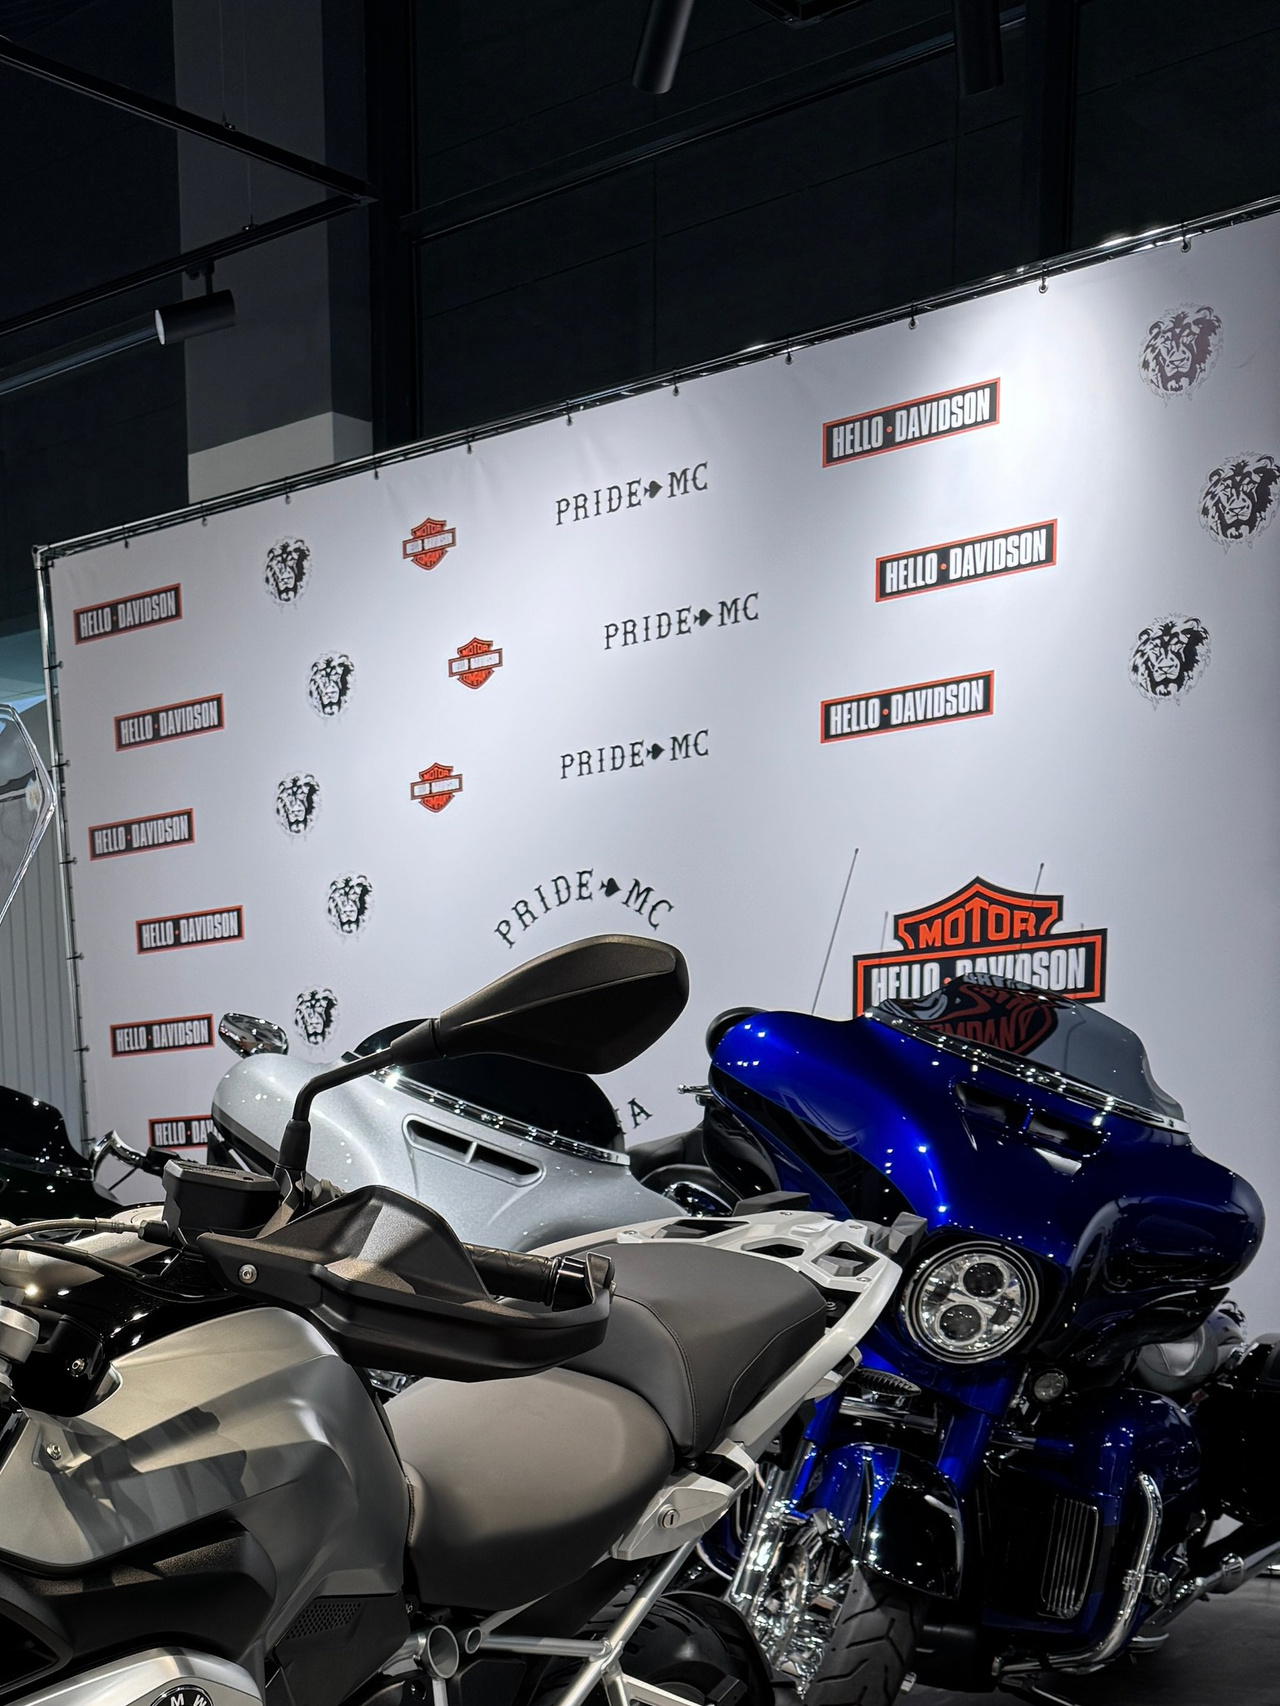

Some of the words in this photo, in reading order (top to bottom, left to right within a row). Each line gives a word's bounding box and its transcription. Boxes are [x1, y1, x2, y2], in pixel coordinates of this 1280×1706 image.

[832, 415, 884, 459] HELLO
[894, 387, 991, 443] DAVIDSON
[555, 477, 643, 526] PRIDE
[667, 461, 709, 499] MC
[885, 552, 938, 594] HELLO
[948, 528, 1047, 580] DAVIDSON
[79, 606, 112, 639] HELLO
[117, 590, 176, 629] DAVIDSON
[604, 605, 693, 650] PRIDE
[717, 592, 760, 628] MC
[120, 714, 153, 745] HELLO
[158, 700, 219, 737] DAVIDSON
[829, 697, 881, 736] HELLO
[890, 679, 984, 725] DAVIDSON
[559, 739, 646, 780] PRIDE
[670, 728, 710, 761] MC
[94, 826, 127, 855] HELLO
[131, 814, 189, 848] DAVIDSON
[141, 920, 175, 949] HELLO
[179, 910, 239, 943] DAVIDSON
[494, 868, 594, 949] PRIDE
[621, 878, 675, 931] MC
[918, 896, 1036, 949] MOTOR
[115, 1026, 148, 1053] HELLO
[152, 1019, 209, 1049] DAVIDSON
[154, 1121, 186, 1146] HELLO
